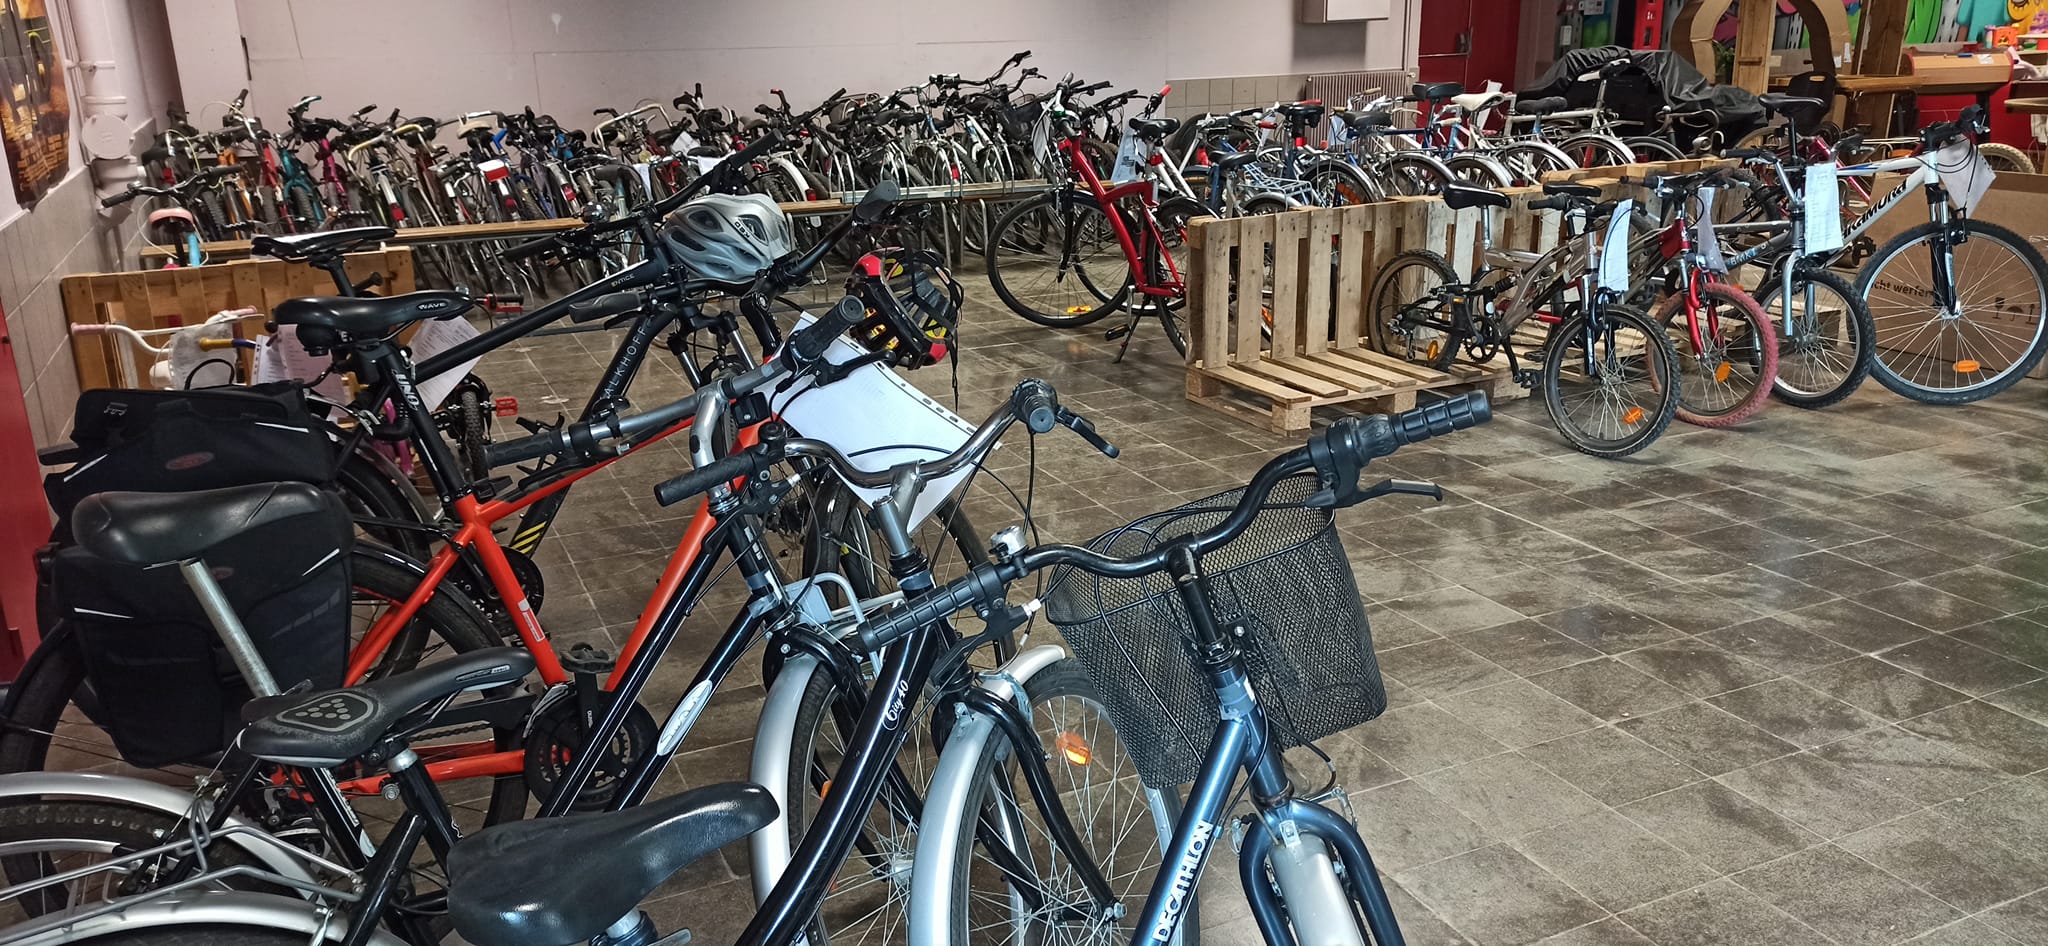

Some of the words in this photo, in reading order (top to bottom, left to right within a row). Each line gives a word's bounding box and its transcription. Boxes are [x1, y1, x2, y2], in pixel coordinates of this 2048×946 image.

[418, 302, 446, 310] WAVE
[602, 326, 647, 399] ALKHOFF
[896, 679, 909, 699] 40
[1152, 819, 1215, 942] DECATHLON
